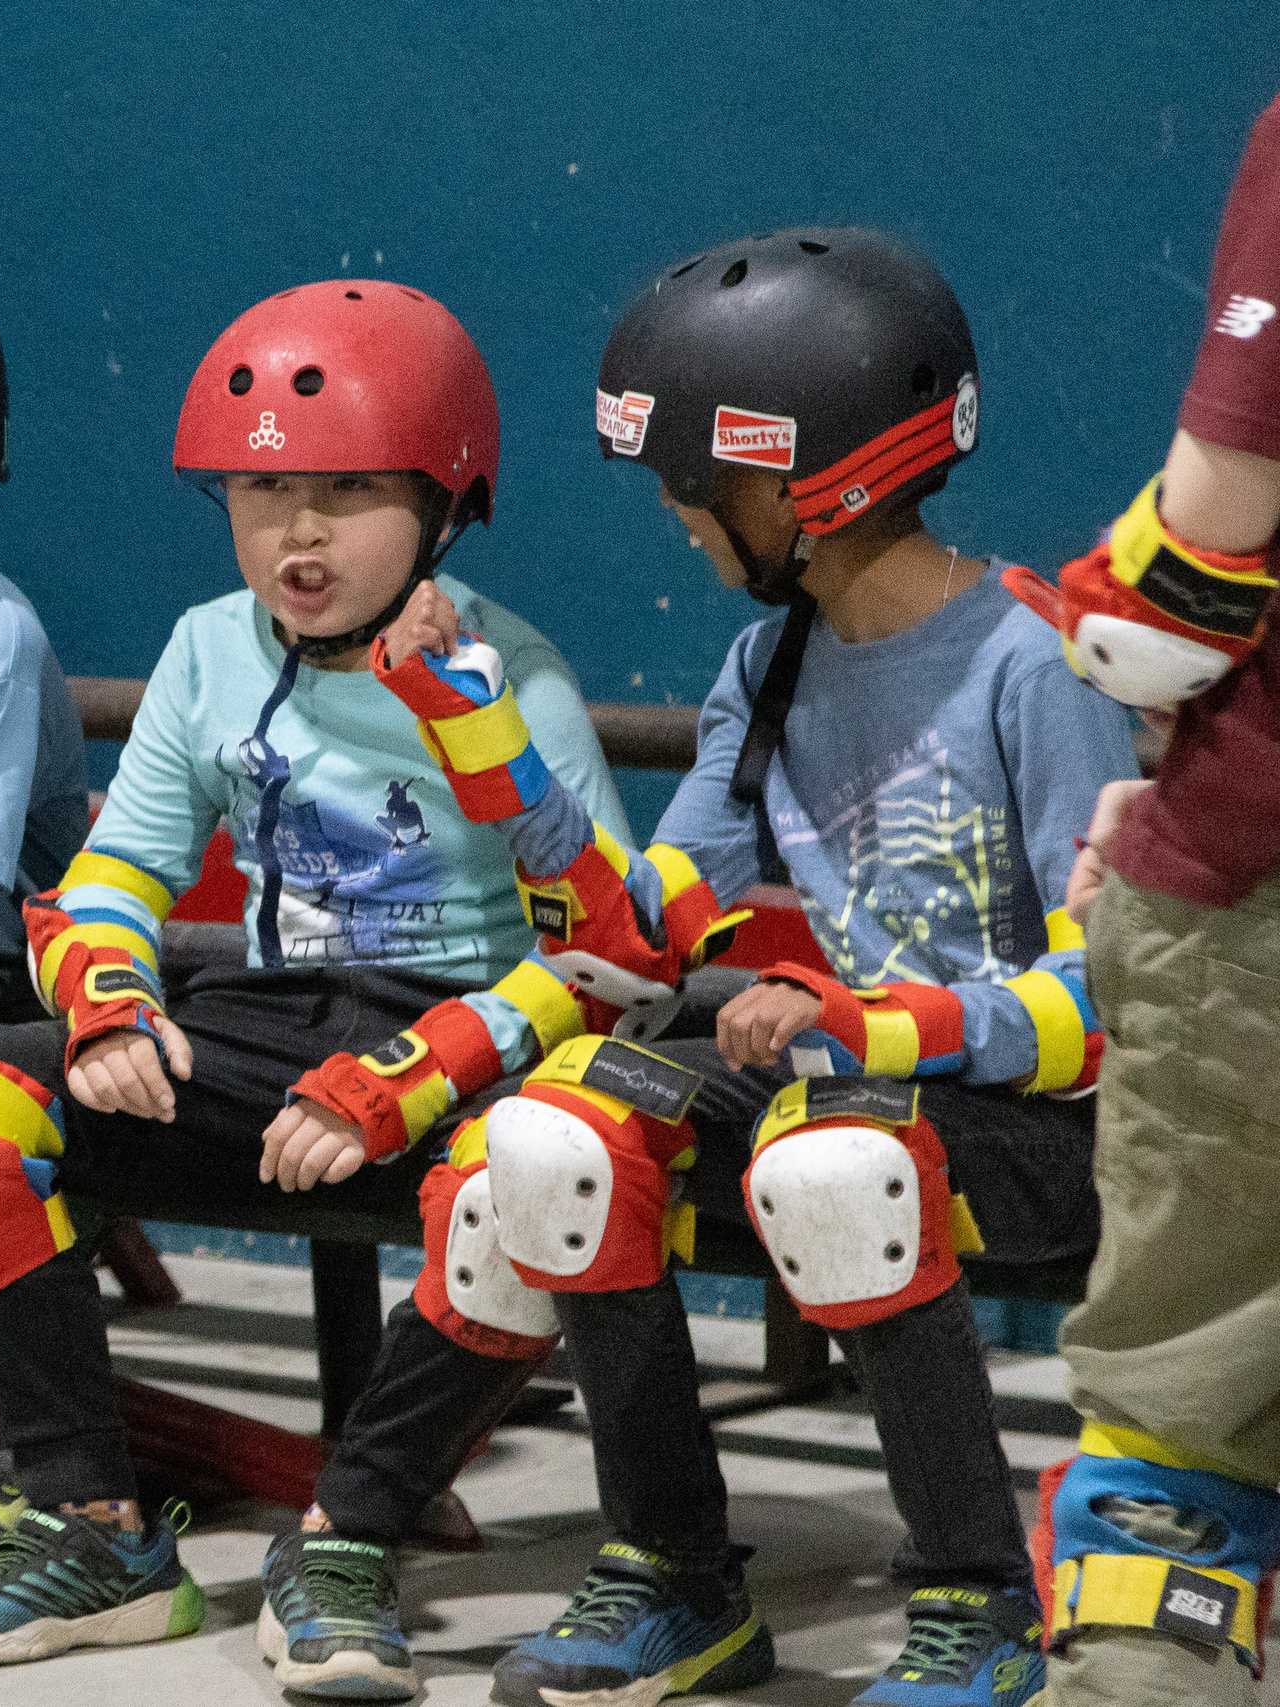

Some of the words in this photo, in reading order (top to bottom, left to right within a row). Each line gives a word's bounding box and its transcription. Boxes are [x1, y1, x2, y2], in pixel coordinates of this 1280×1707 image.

[717, 425, 792, 449] Shorty's
[387, 900, 448, 925] DAY
[302, 1540, 385, 1559] SKECHERS
